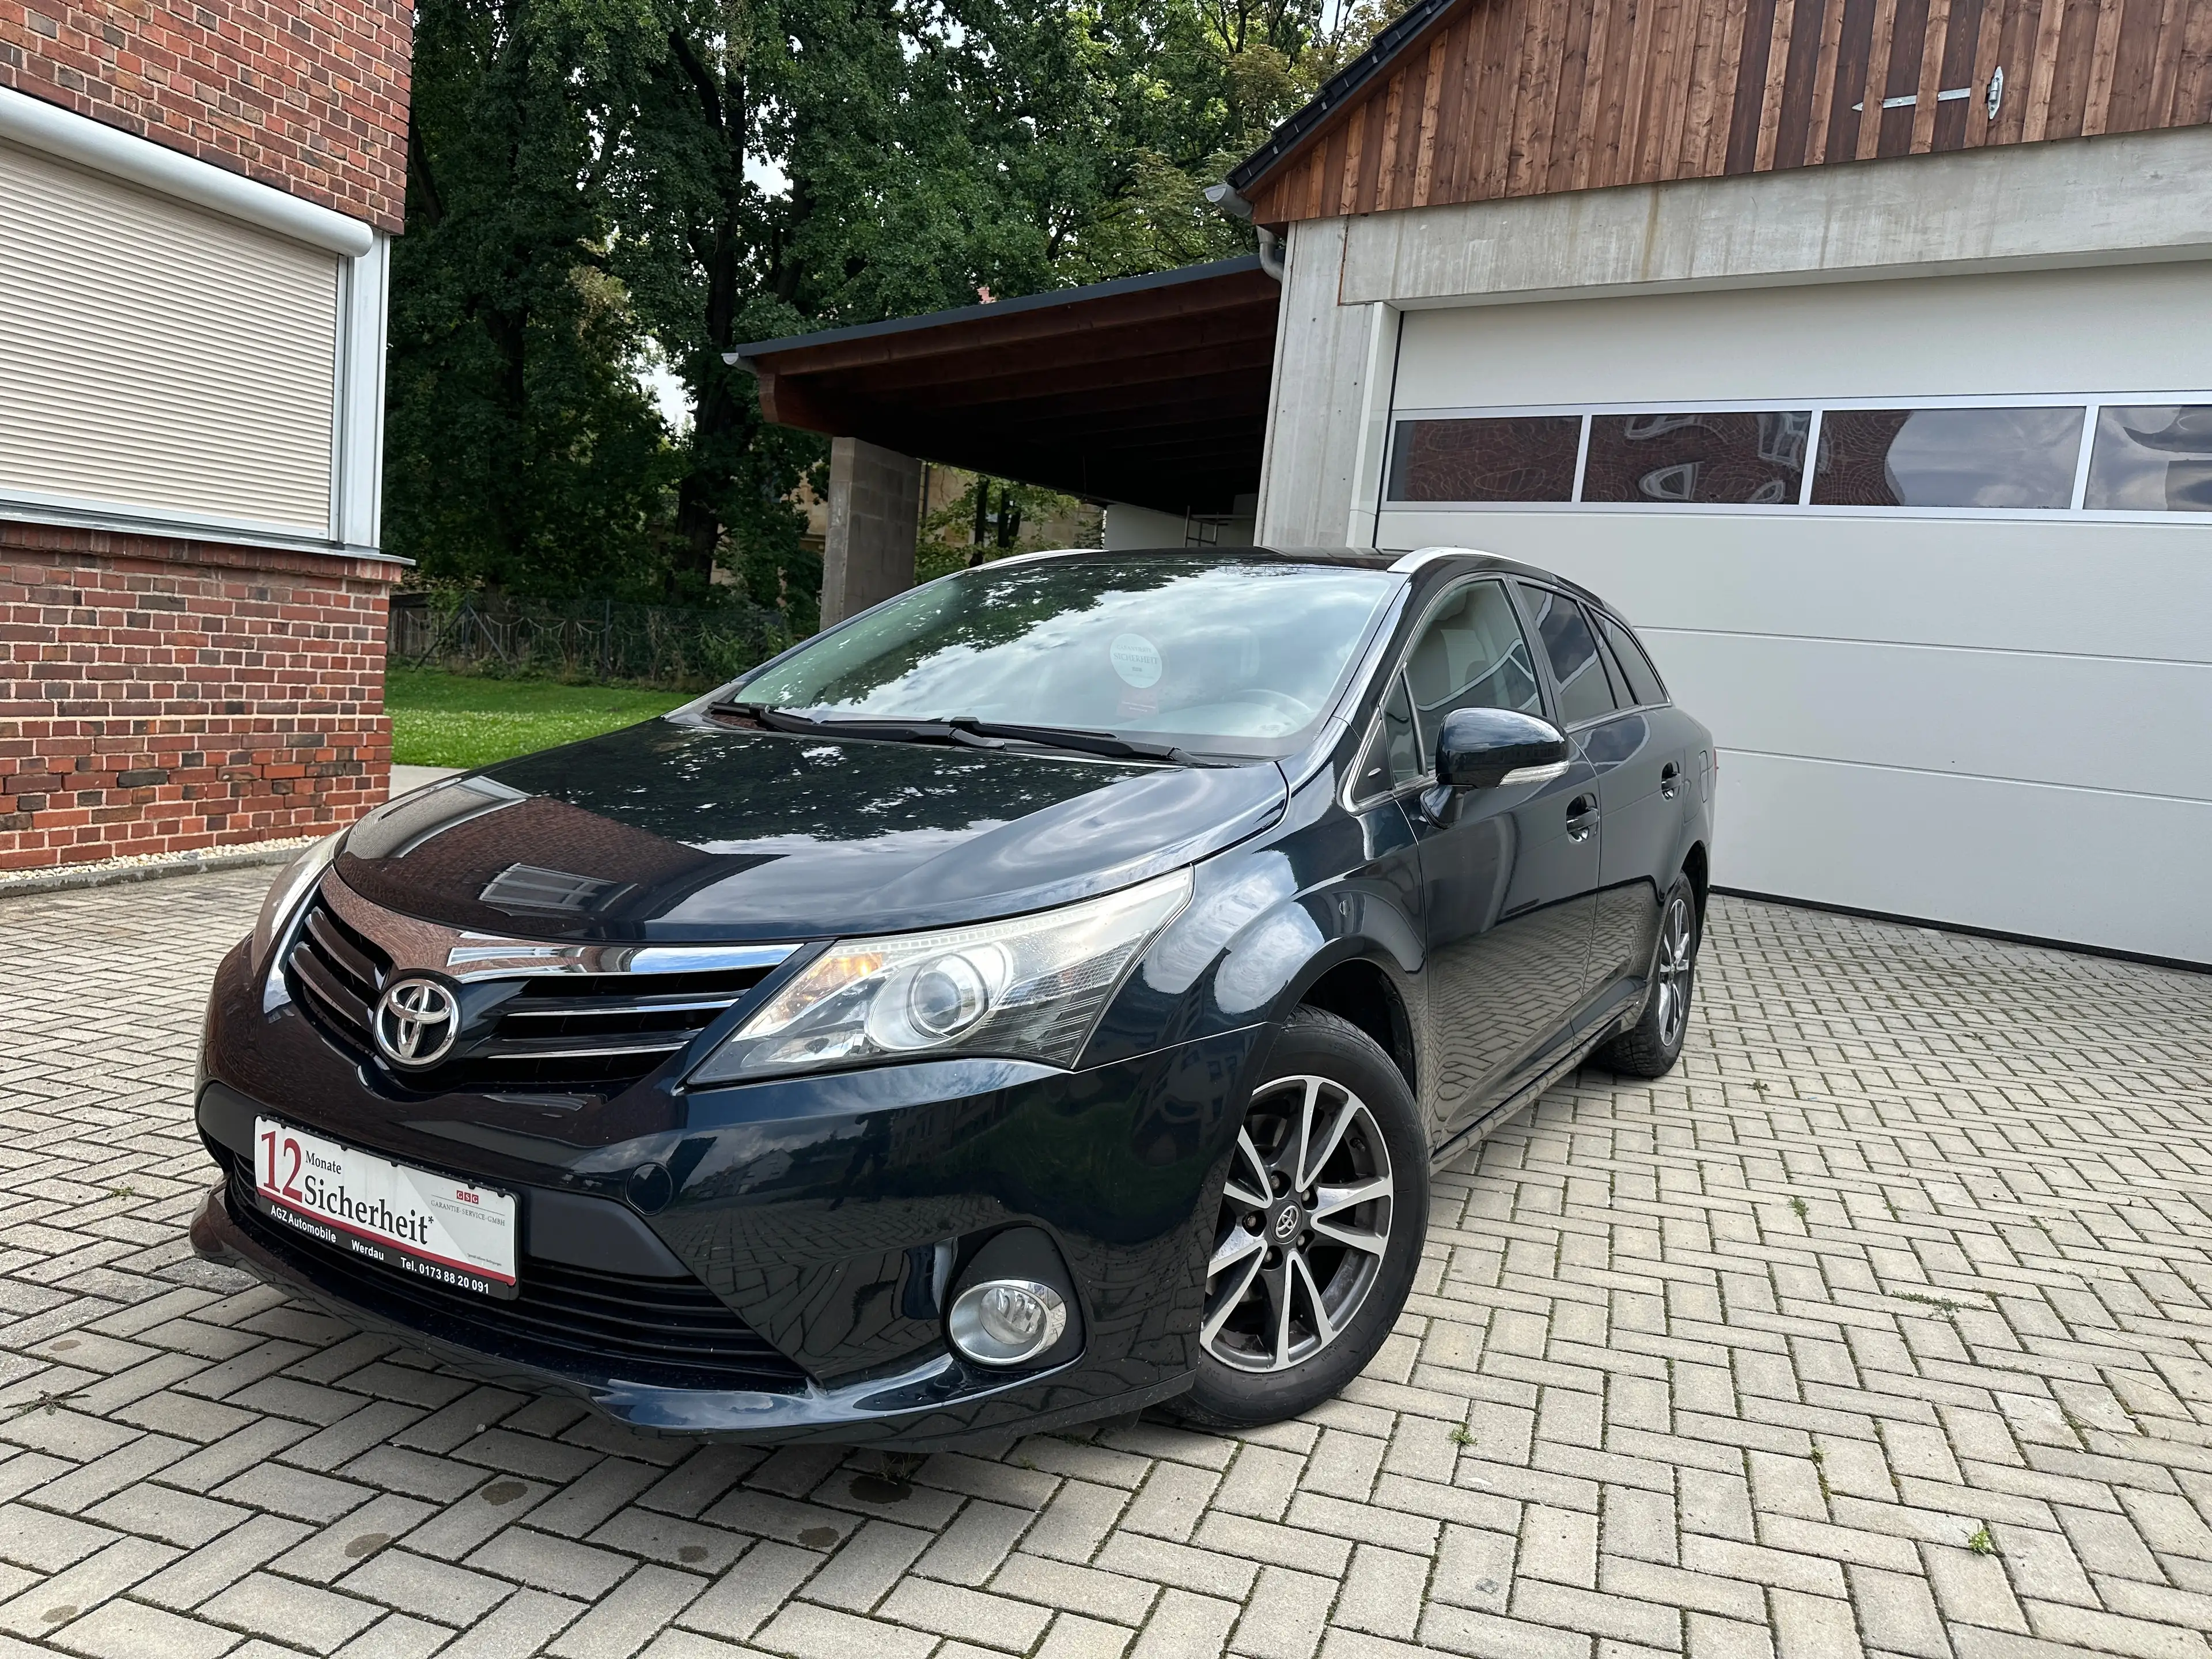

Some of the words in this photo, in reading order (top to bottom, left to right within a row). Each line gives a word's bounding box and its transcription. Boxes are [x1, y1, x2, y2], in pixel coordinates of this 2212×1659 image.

[1113, 653, 1157, 664] SICHERHEIT
[261, 1131, 302, 1203] 12
[305, 1150, 342, 1175] Monate
[457, 1190, 479, 1205] GSG
[271, 1205, 287, 1222] AGZ
[289, 1213, 336, 1243] Automobile
[351, 1239, 384, 1261] Werdau
[400, 1257, 417, 1272] Tel.
[419, 1263, 441, 1279] 0173
[444, 1271, 456, 1284] 88
[457, 1275, 469, 1288] 20
[472, 1279, 489, 1294] 091
